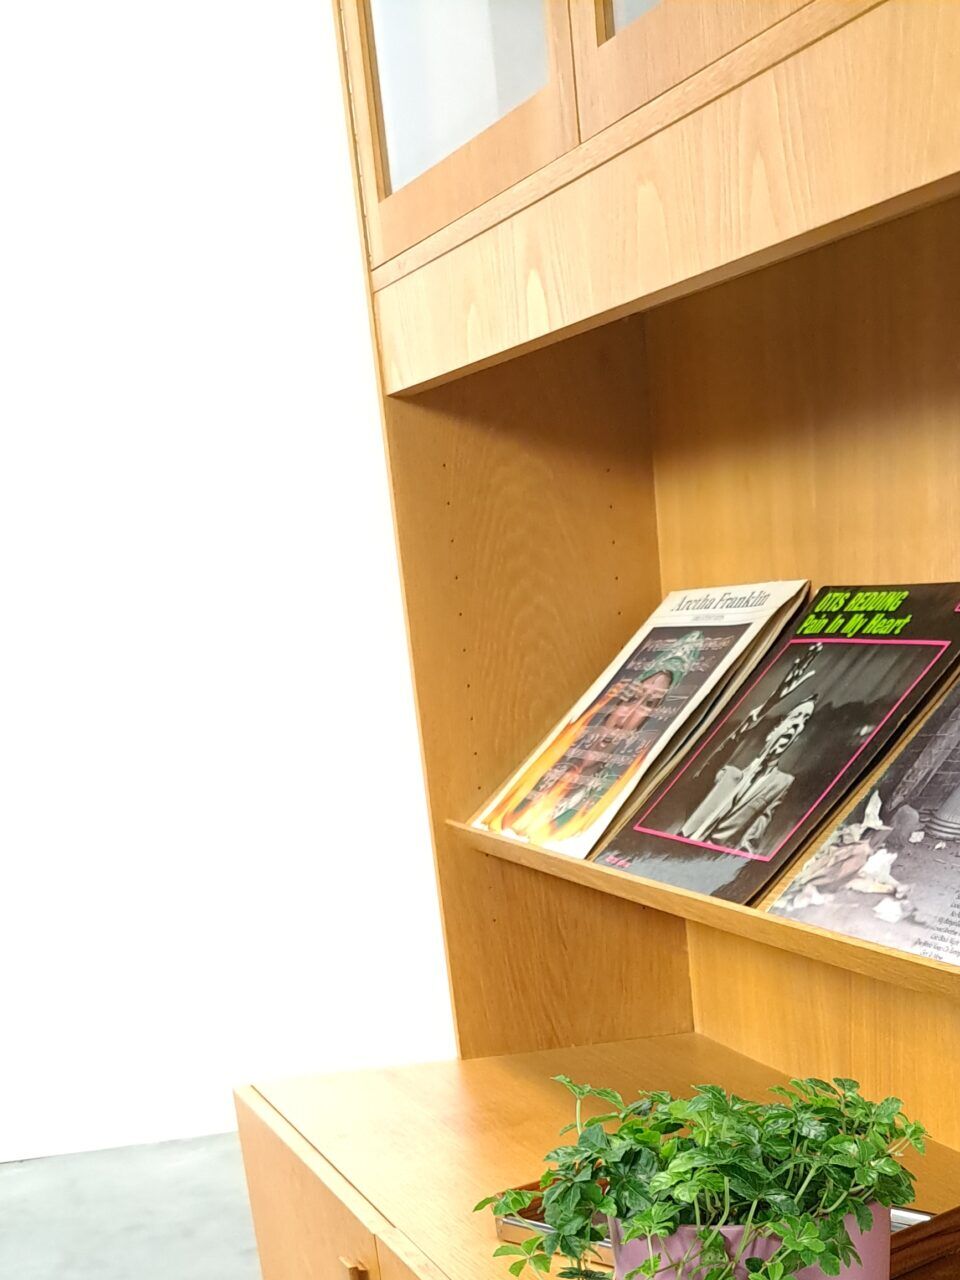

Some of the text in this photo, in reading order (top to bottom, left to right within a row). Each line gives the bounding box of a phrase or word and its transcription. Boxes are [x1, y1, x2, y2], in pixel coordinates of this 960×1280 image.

[671, 590, 770, 611] Aretha Franklin
[814, 590, 909, 612] OTIS REDDING
[796, 613, 913, 638] Pain In My Heart
